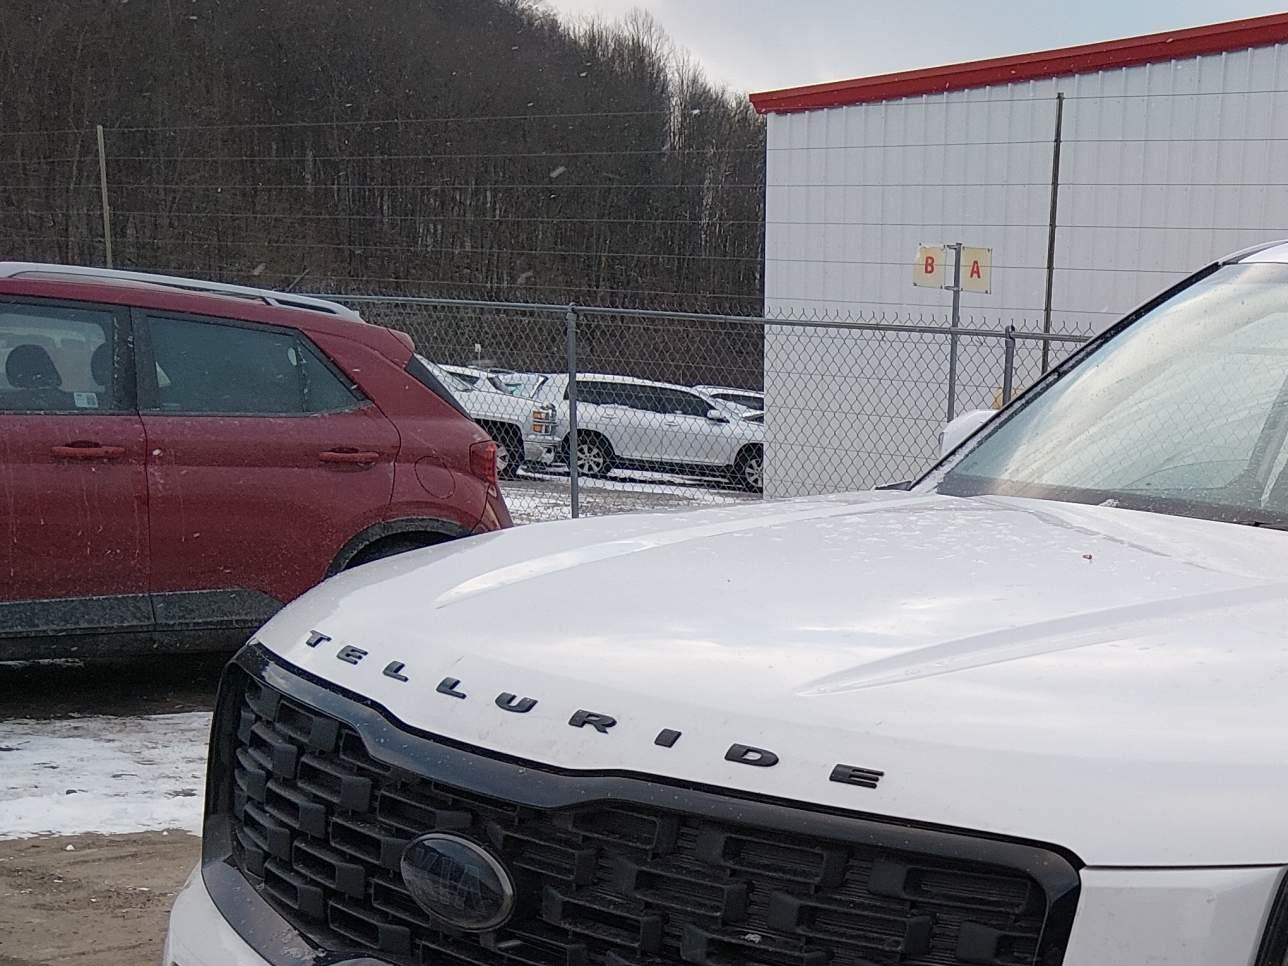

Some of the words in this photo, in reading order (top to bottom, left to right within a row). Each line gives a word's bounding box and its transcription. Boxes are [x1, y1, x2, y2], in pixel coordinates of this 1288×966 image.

[924, 256, 935, 274] B
[970, 260, 981, 279] A
[305, 630, 886, 789] TELLURIDE
